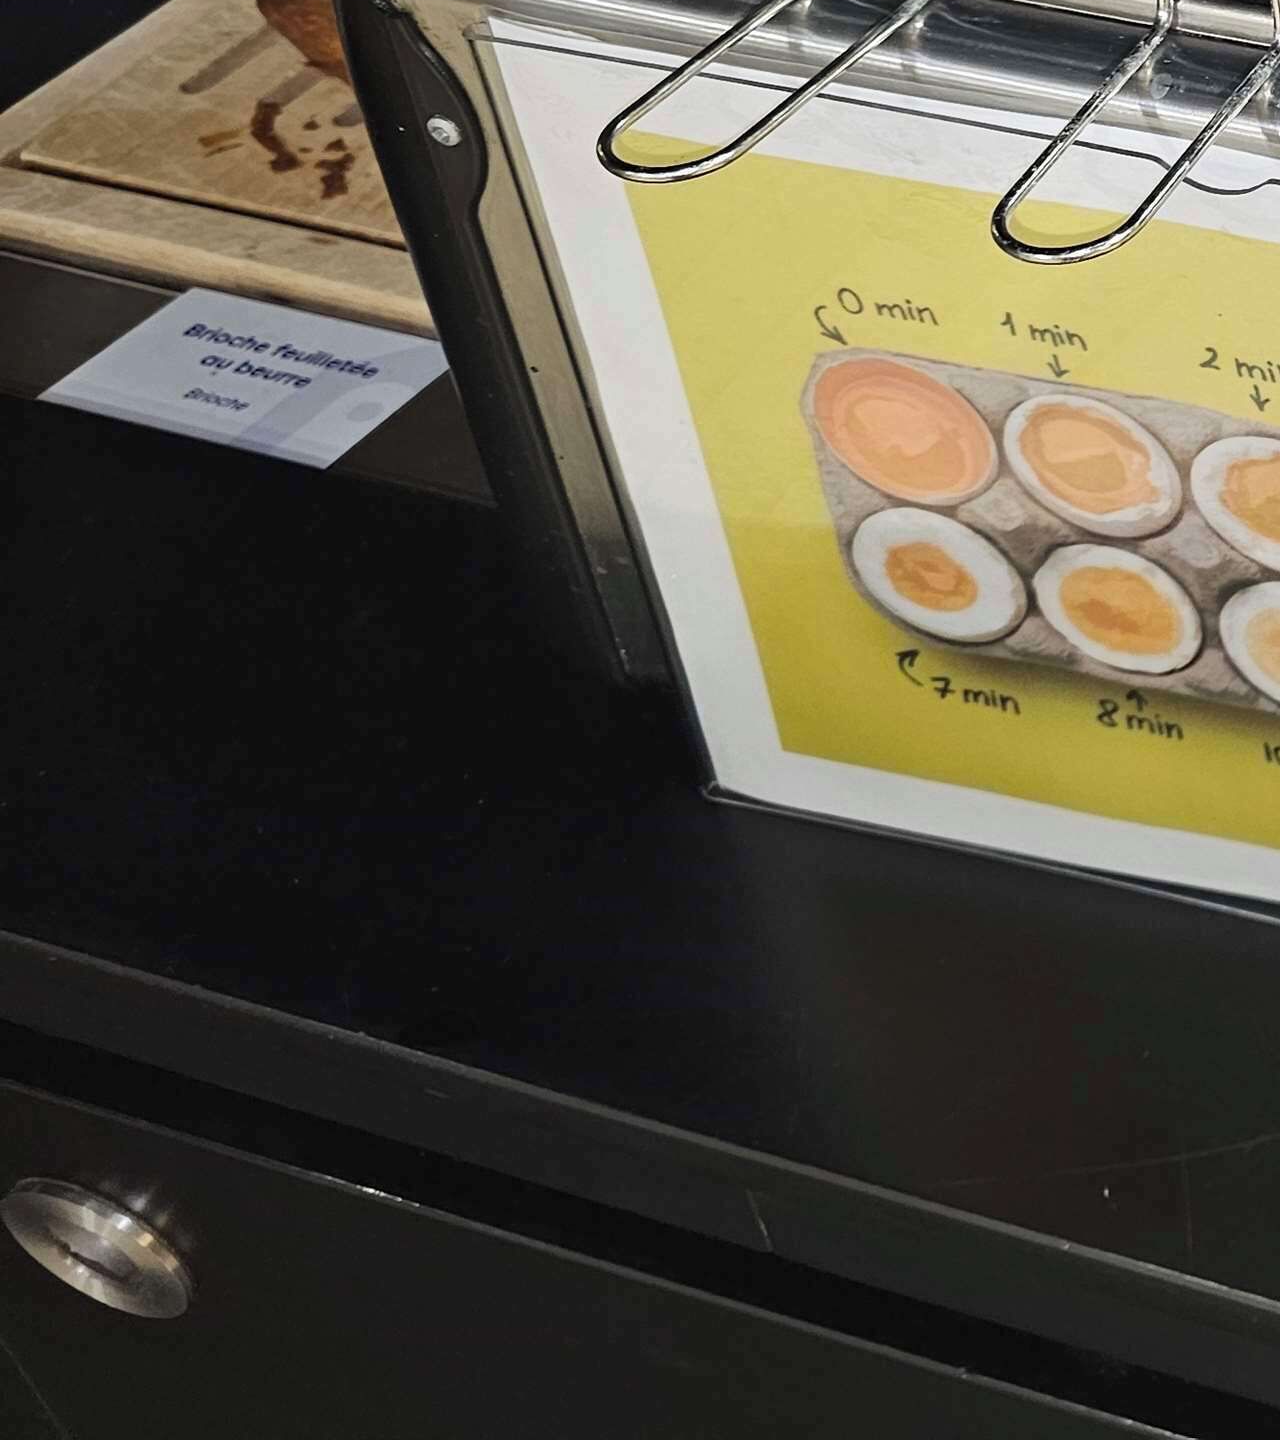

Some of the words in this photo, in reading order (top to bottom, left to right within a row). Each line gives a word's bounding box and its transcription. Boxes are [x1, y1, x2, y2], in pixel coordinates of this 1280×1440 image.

[836, 287, 865, 315] 0
[873, 299, 940, 326] min
[182, 323, 271, 354] Brioche
[270, 343, 380, 379] feuilletée
[1000, 312, 1018, 337] 1
[1028, 323, 1089, 351] min
[200, 355, 234, 371] au
[233, 361, 313, 389] beurre
[1199, 346, 1222, 371] 2
[183, 387, 250, 411] Brioche
[930, 675, 957, 700] 7
[961, 683, 1022, 716] min
[1096, 697, 1121, 729] 8
[1125, 706, 1186, 742] min
